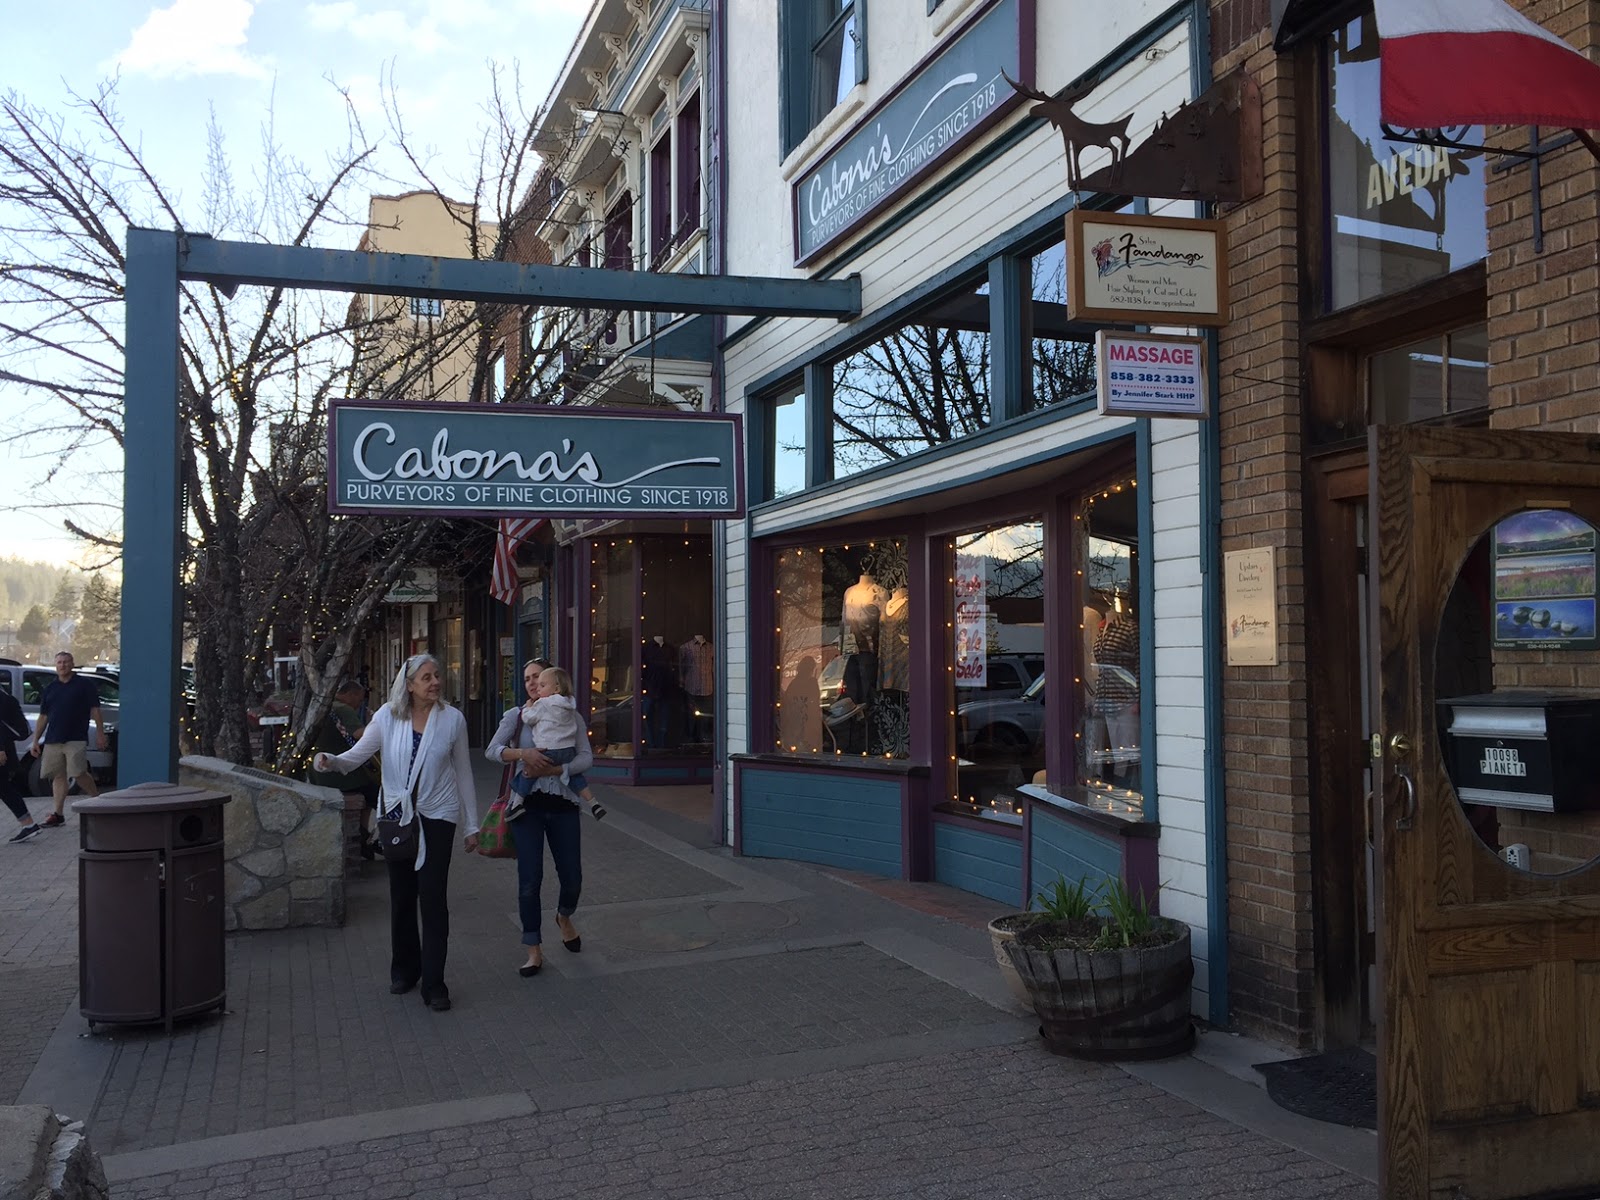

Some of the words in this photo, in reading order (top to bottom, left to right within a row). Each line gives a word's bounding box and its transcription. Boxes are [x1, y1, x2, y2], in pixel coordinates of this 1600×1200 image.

[811, 199, 854, 247] PURVEYORS
[856, 192, 867, 211] OF
[868, 177, 886, 203] FINE
[888, 135, 935, 185] CLOTHING
[937, 109, 969, 147] SINCE
[971, 84, 996, 119] 1918
[1366, 145, 1451, 210] AVEDA
[1139, 236, 1156, 245] Salon
[1118, 232, 1204, 269] Fandango
[1127, 274, 1150, 284] Women
[1151, 277, 1162, 285] and
[1163, 277, 1177, 286] Men
[1107, 283, 1121, 292] Hair
[1122, 285, 1144, 296] Styling
[1154, 287, 1167, 296] Cut
[1167, 288, 1178, 297] and
[1179, 288, 1197, 298] Color
[1110, 344, 1194, 365] MASSAGE
[1110, 371, 1194, 384] 858-382-3333
[1111, 389, 1122, 397] By
[1124, 390, 1153, 398] Jennifer
[1155, 391, 1174, 399] Stark
[1176, 392, 1195, 400] HHP
[353, 422, 720, 489] Cabona's
[346, 484, 455, 502] PURVEYORS
[464, 485, 491, 503] OF
[497, 486, 533, 503] FINE
[540, 487, 632, 504] CLOTHING
[641, 489, 690, 505] SINCE
[695, 489, 729, 505] 1918
[956, 656, 983, 679] Sale
[1487, 748, 1518, 762] 10098
[1481, 761, 1526, 775] PIANETA
